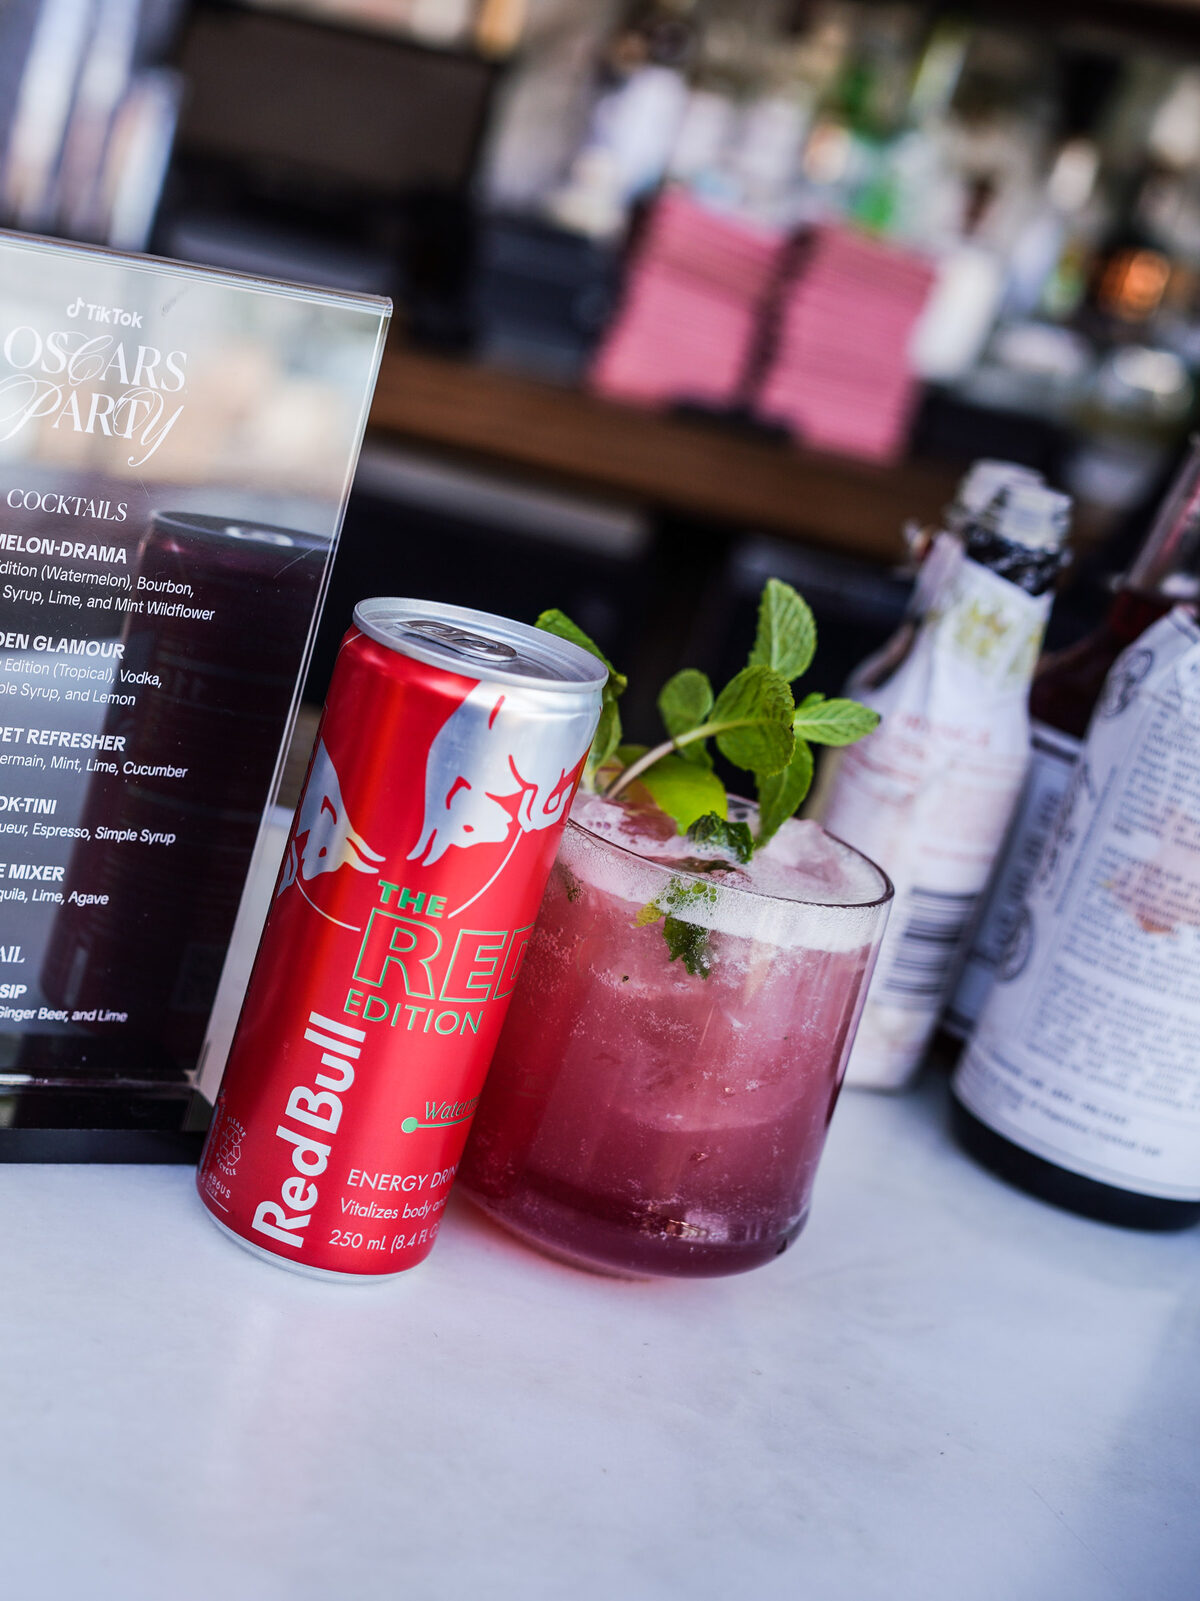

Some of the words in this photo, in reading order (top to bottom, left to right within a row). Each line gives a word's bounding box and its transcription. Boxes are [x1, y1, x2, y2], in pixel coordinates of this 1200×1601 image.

[86, 303, 144, 329] TikTok
[3, 326, 188, 393] OSCARS
[6, 488, 128, 522] COCKTAILS
[41, 564, 133, 591] (Watermelon),
[136, 576, 194, 598] Bourbon,
[2, 584, 45, 605] Syrup,
[48, 590, 83, 609] Lime,
[86, 597, 114, 610] and
[114, 597, 144, 613] Mint
[147, 601, 216, 621] Wildflower
[32, 635, 126, 660] GLAMOUR
[4, 658, 50, 675] Edition
[53, 662, 115, 684] (Tropical),
[119, 669, 163, 689] Vodka,
[19, 682, 61, 702] Syrup,
[64, 689, 91, 702] and
[92, 690, 136, 706] Lemon
[26, 728, 127, 752] REFRESHER
[50, 755, 83, 773] Mint,
[86, 758, 119, 776] Lime,
[122, 761, 188, 778] Cucumber
[32, 822, 92, 842] Espresso,
[94, 826, 138, 844] Simple
[139, 829, 177, 847] Syrup
[8, 863, 66, 882] MIXER
[31, 888, 66, 905] Lime,
[67, 890, 110, 908] Agave
[377, 879, 449, 919] THE
[37, 1007, 69, 1023] Beer,
[71, 1009, 97, 1022] and
[97, 1009, 128, 1023] Lime
[343, 987, 484, 1036] EDITION
[425, 1097, 480, 1120] Waterm
[346, 1168, 429, 1192] ENERGY
[429, 1161, 460, 1189] DRIN
[340, 1197, 399, 1220] Vitalizes
[401, 1199, 432, 1220] body
[328, 1229, 363, 1249] 250
[366, 1234, 387, 1251] mL
[390, 1232, 416, 1254] (8.4
